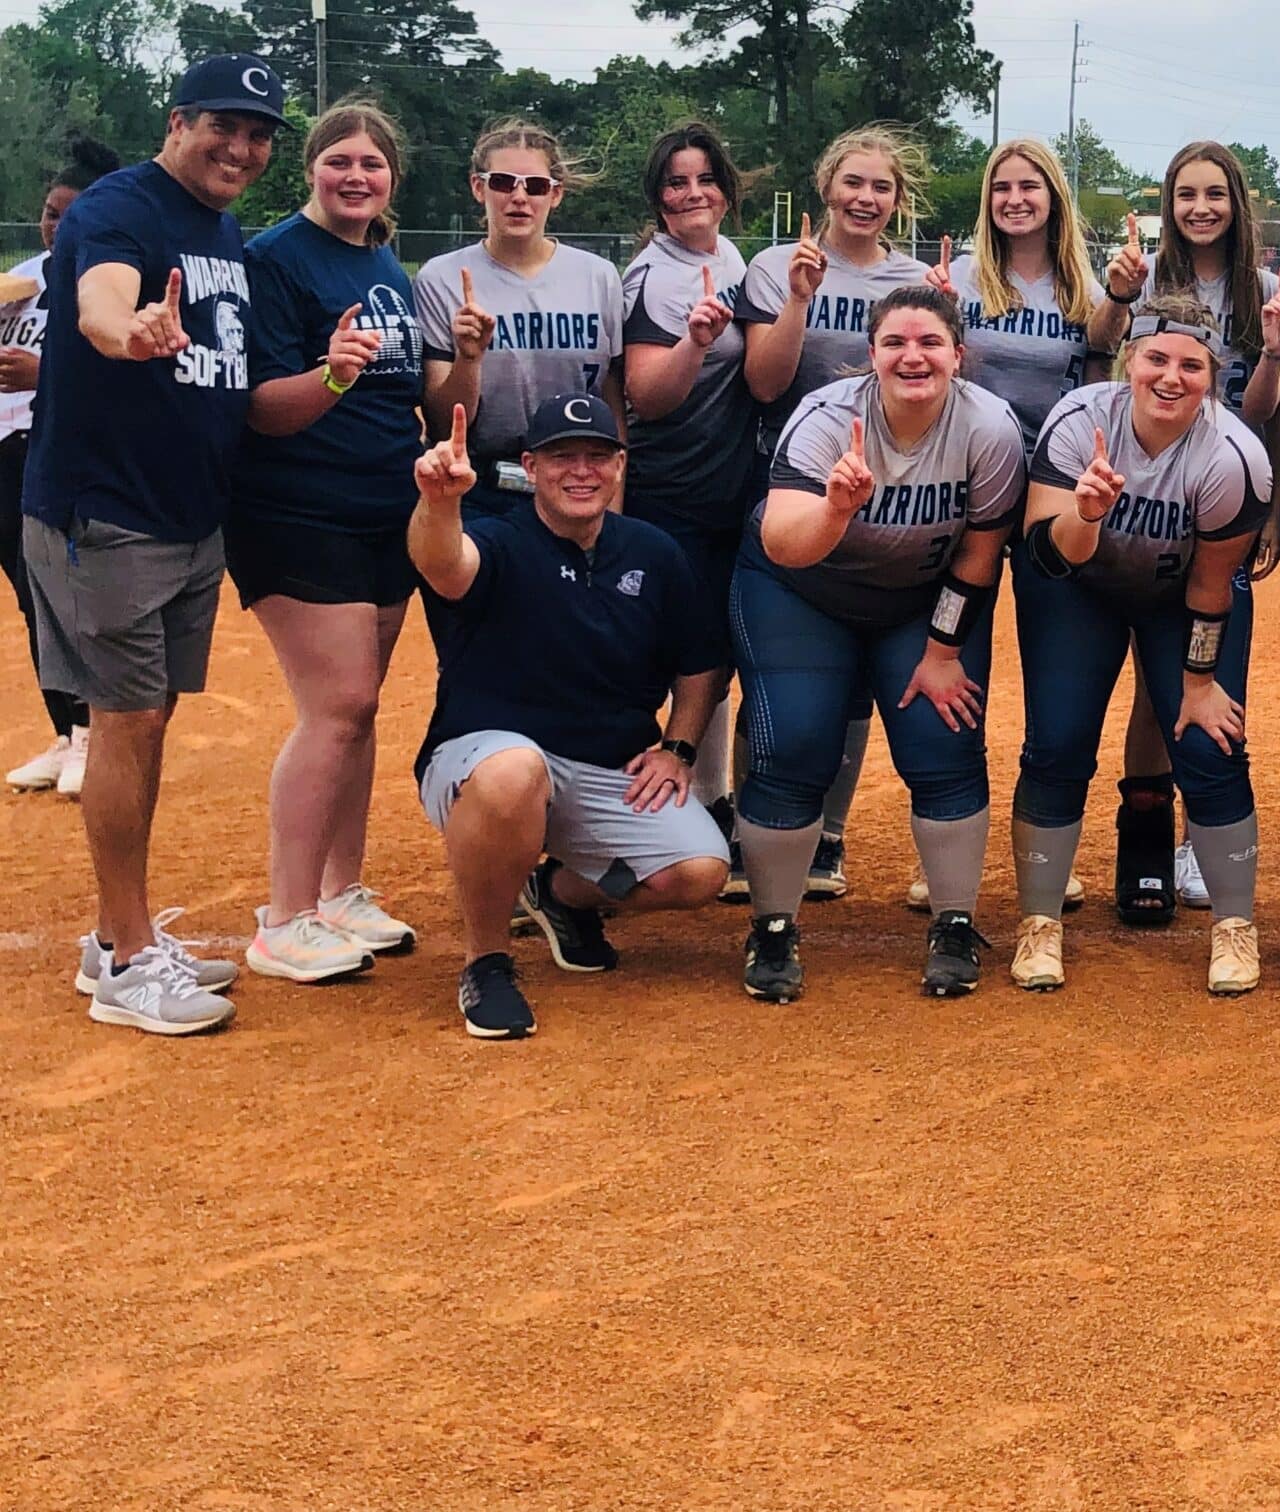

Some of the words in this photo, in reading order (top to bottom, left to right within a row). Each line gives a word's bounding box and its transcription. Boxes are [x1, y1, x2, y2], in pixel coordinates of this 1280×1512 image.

[241, 67, 269, 97] C
[180, 253, 251, 308] WARRIO
[488, 312, 600, 350] ARRIORS
[174, 342, 249, 390] SOFTB
[563, 399, 593, 424] C
[853, 480, 968, 526] ARRIORS
